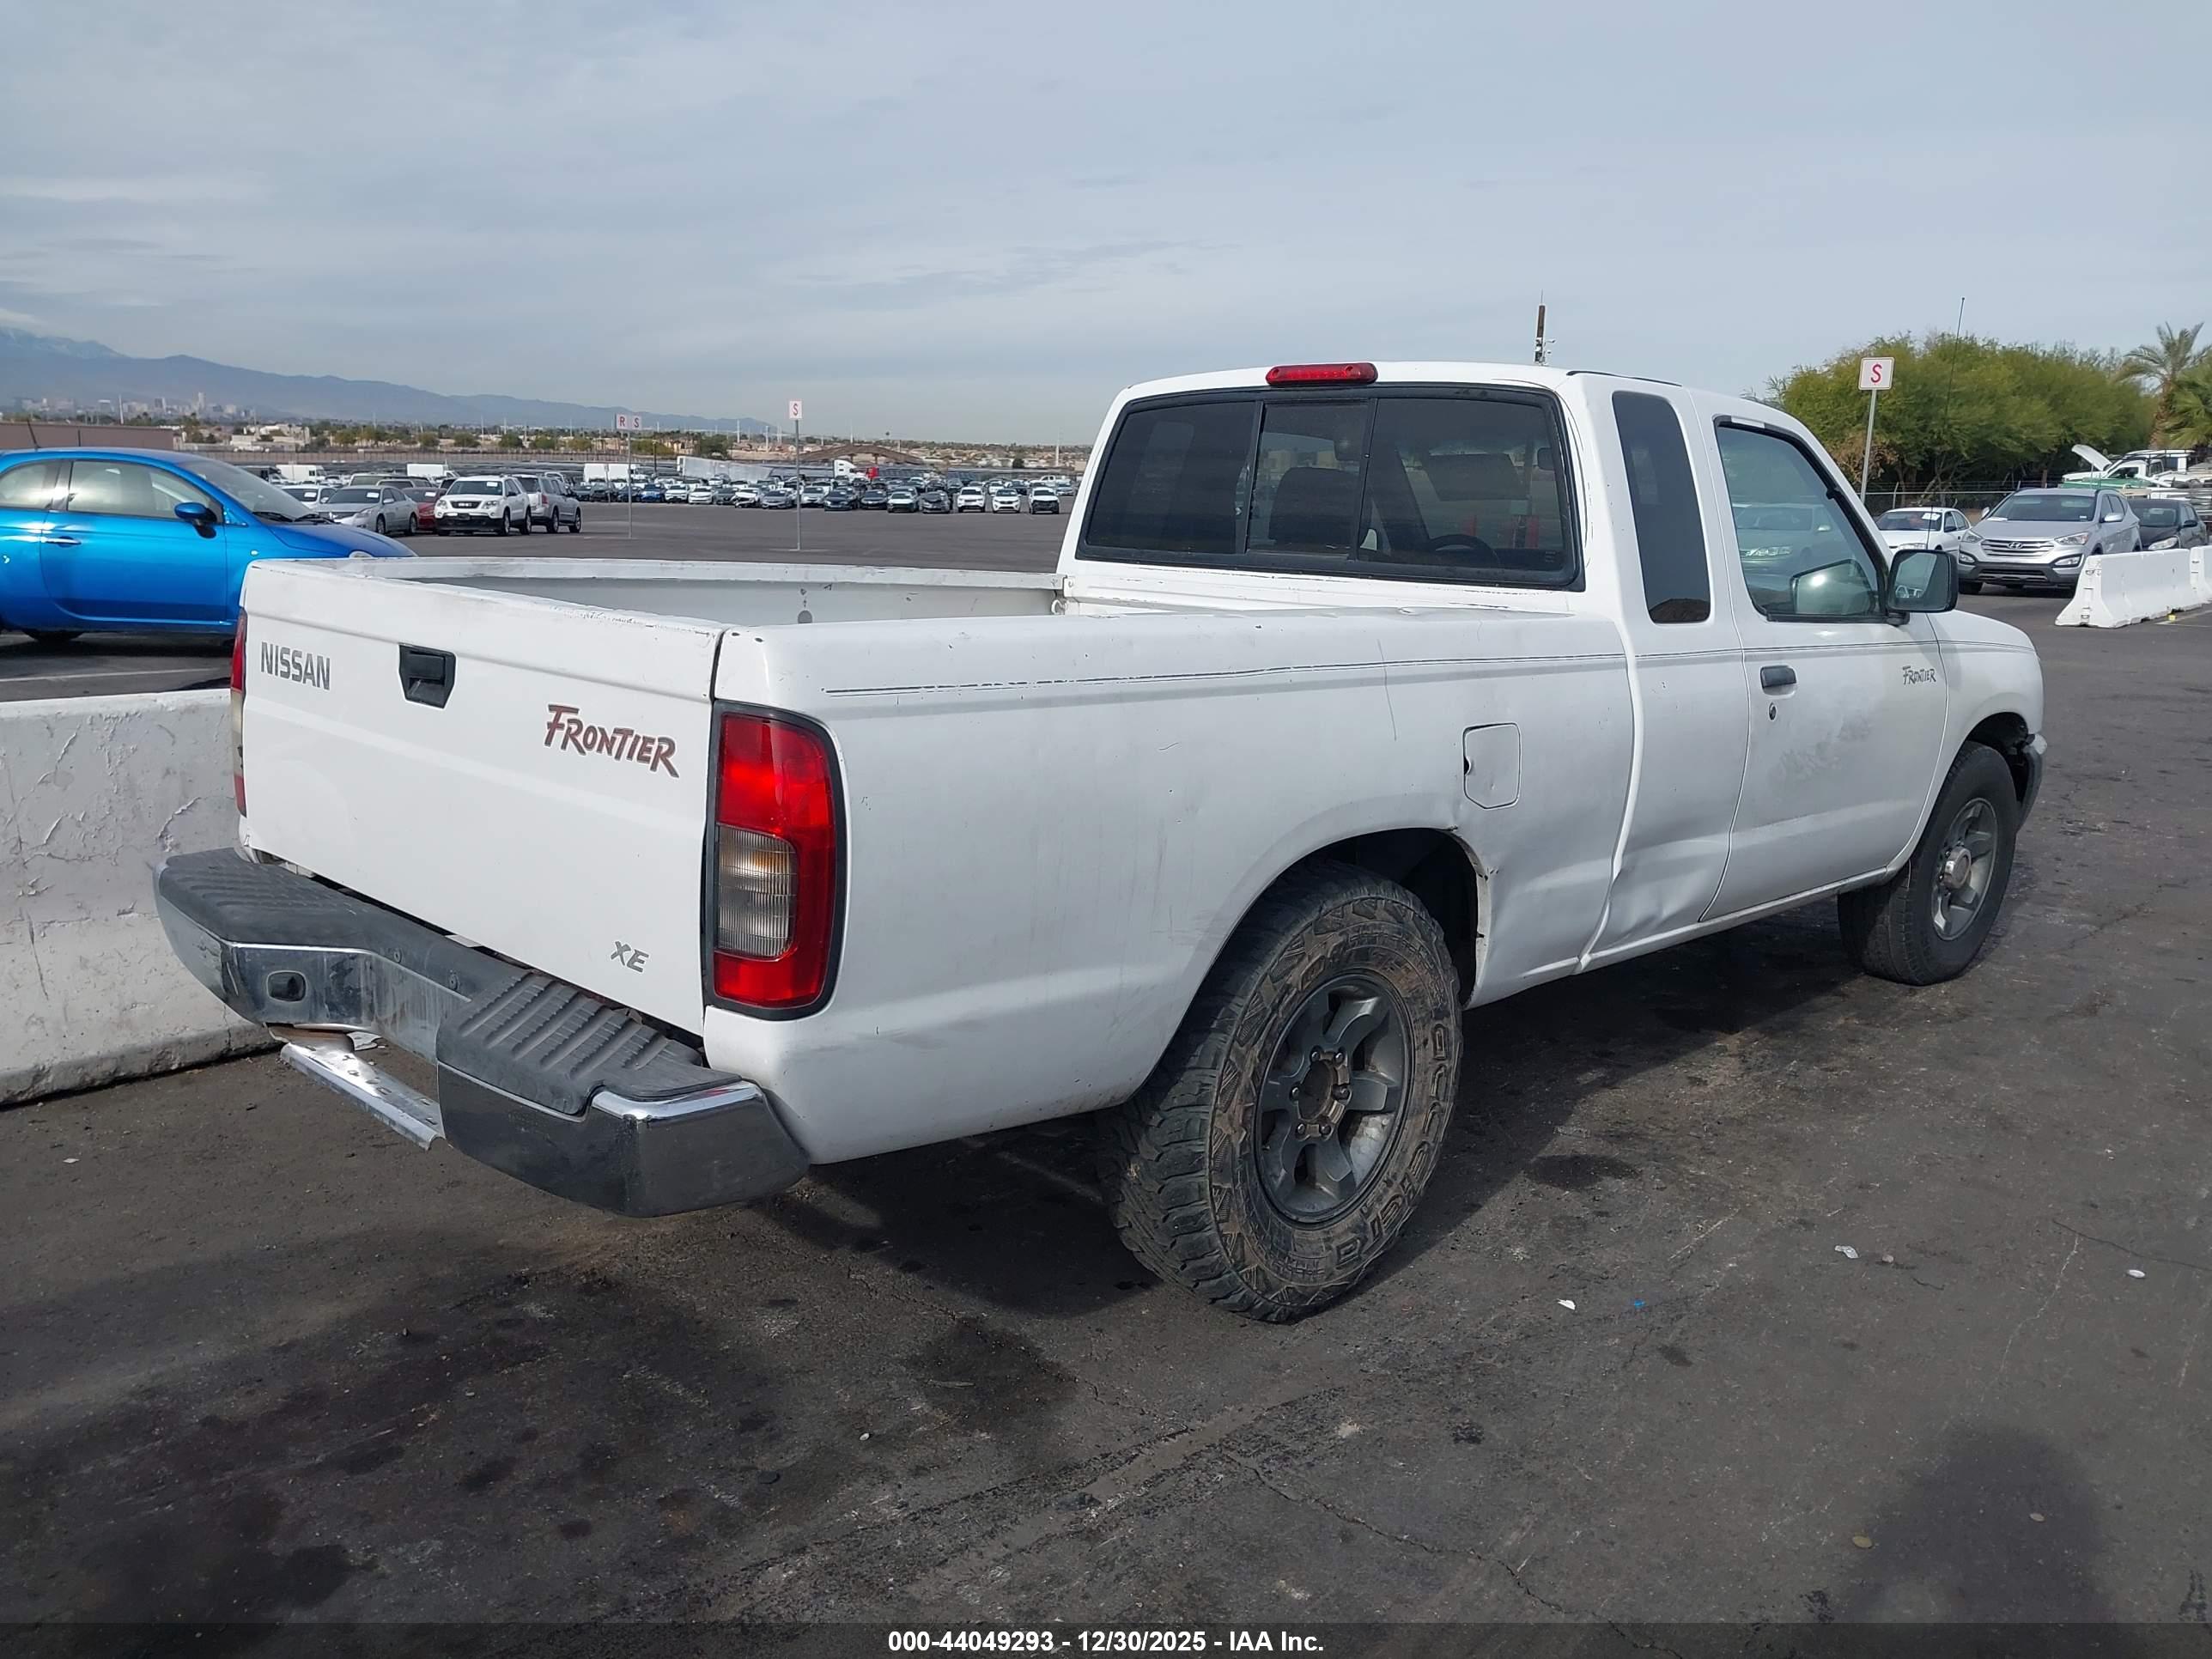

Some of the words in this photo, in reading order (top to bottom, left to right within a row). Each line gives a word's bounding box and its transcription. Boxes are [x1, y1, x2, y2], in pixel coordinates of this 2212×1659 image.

[1870, 363, 1883, 383] S
[618, 416, 626, 428] R
[633, 416, 641, 428] S
[792, 403, 799, 416] S
[260, 641, 331, 691] NISSAN
[544, 702, 680, 778] FRONTIER
[611, 940, 650, 973] XE
